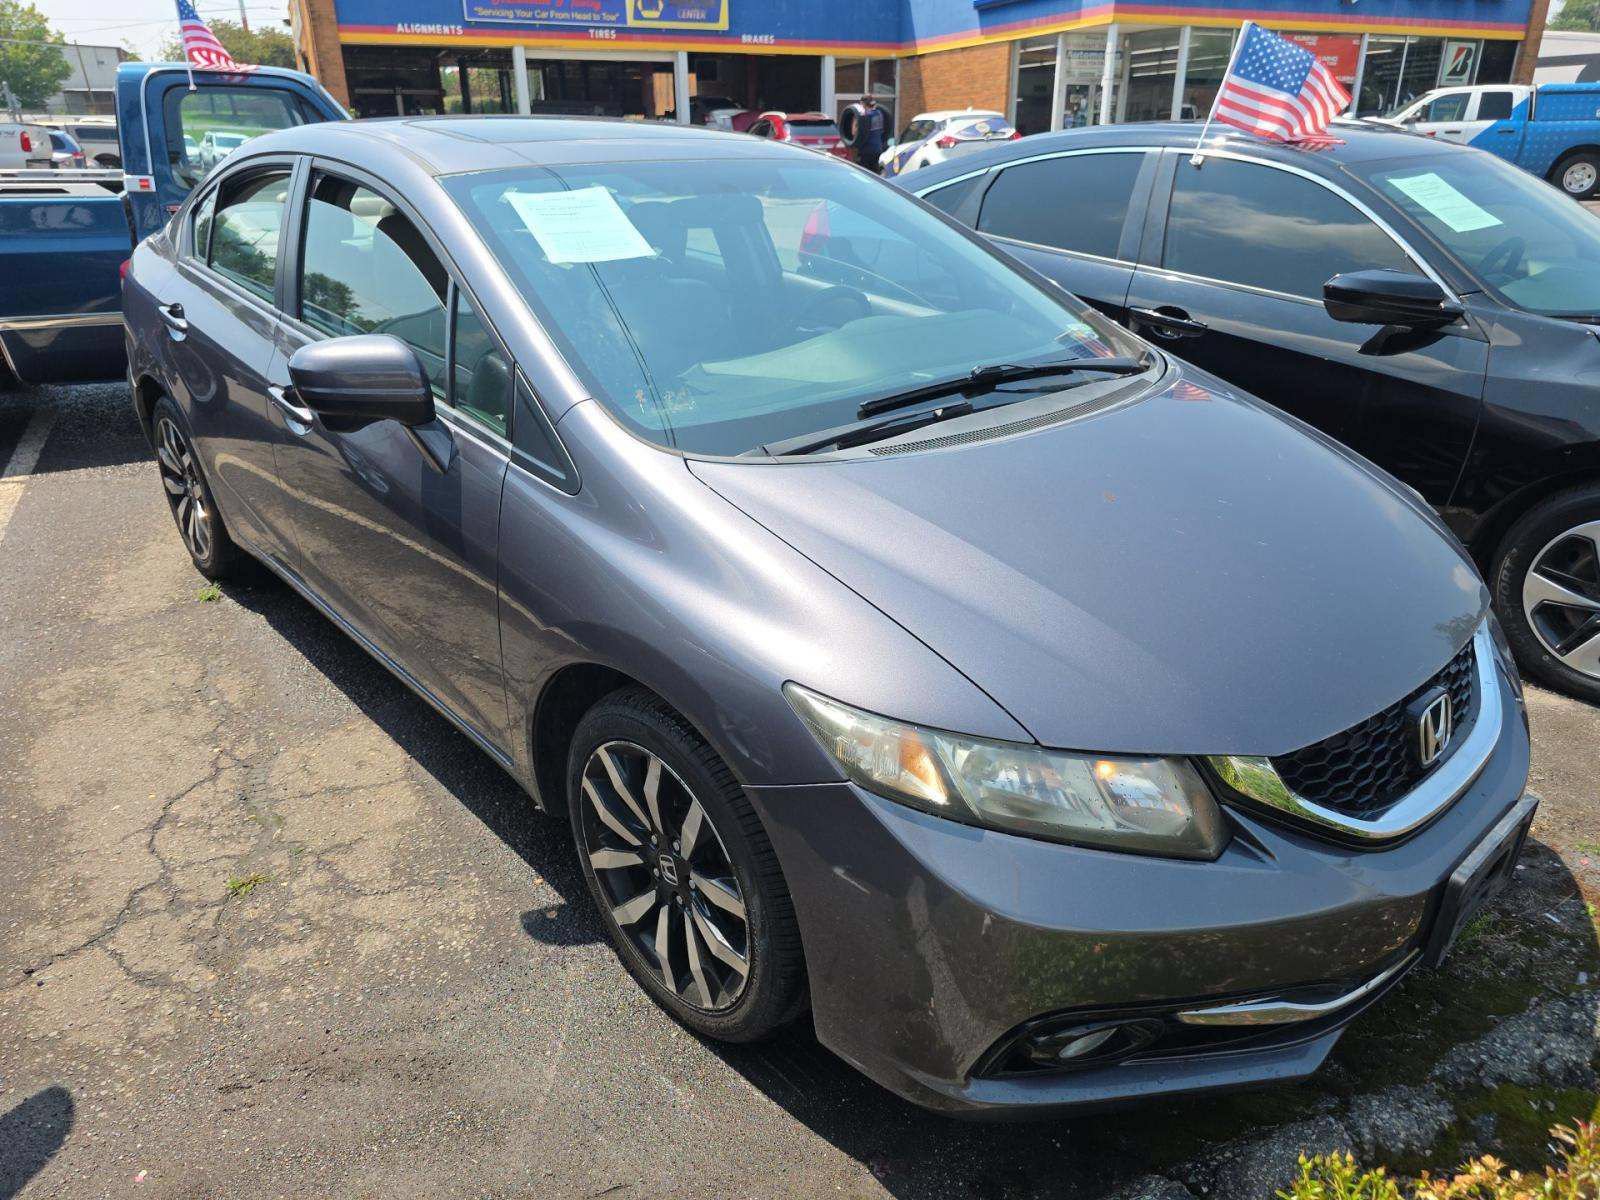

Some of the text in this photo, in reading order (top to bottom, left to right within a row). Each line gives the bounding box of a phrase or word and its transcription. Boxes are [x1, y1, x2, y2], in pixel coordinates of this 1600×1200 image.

[515, 9, 532, 18] Your
[534, 10, 548, 18] Car
[550, 10, 570, 20] From
[397, 23, 464, 35] ALIGNMENTS
[588, 28, 617, 40] TIRES
[741, 34, 775, 45] BRAKES
